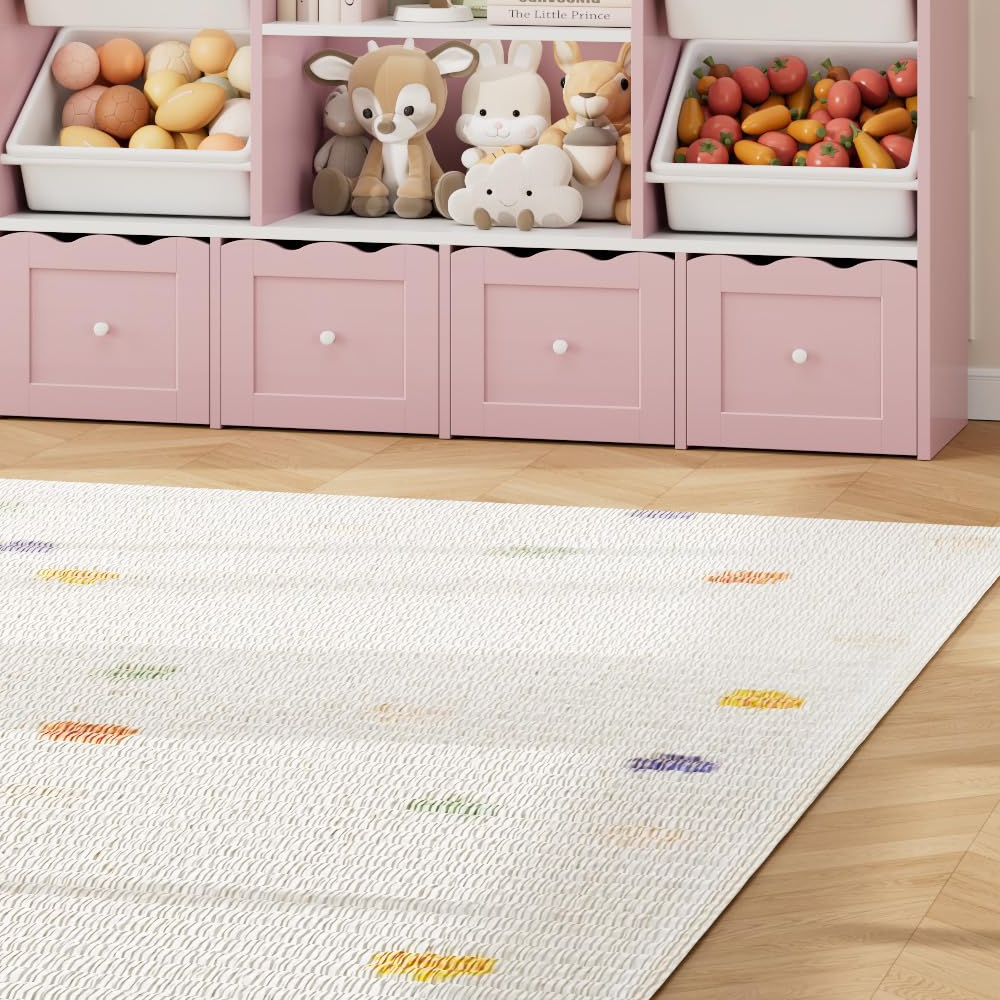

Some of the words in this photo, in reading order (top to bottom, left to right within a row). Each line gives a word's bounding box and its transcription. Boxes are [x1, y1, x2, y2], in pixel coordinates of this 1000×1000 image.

[508, 9, 531, 19] The
[534, 10, 567, 20] Little
[571, 11, 611, 20] Prince
